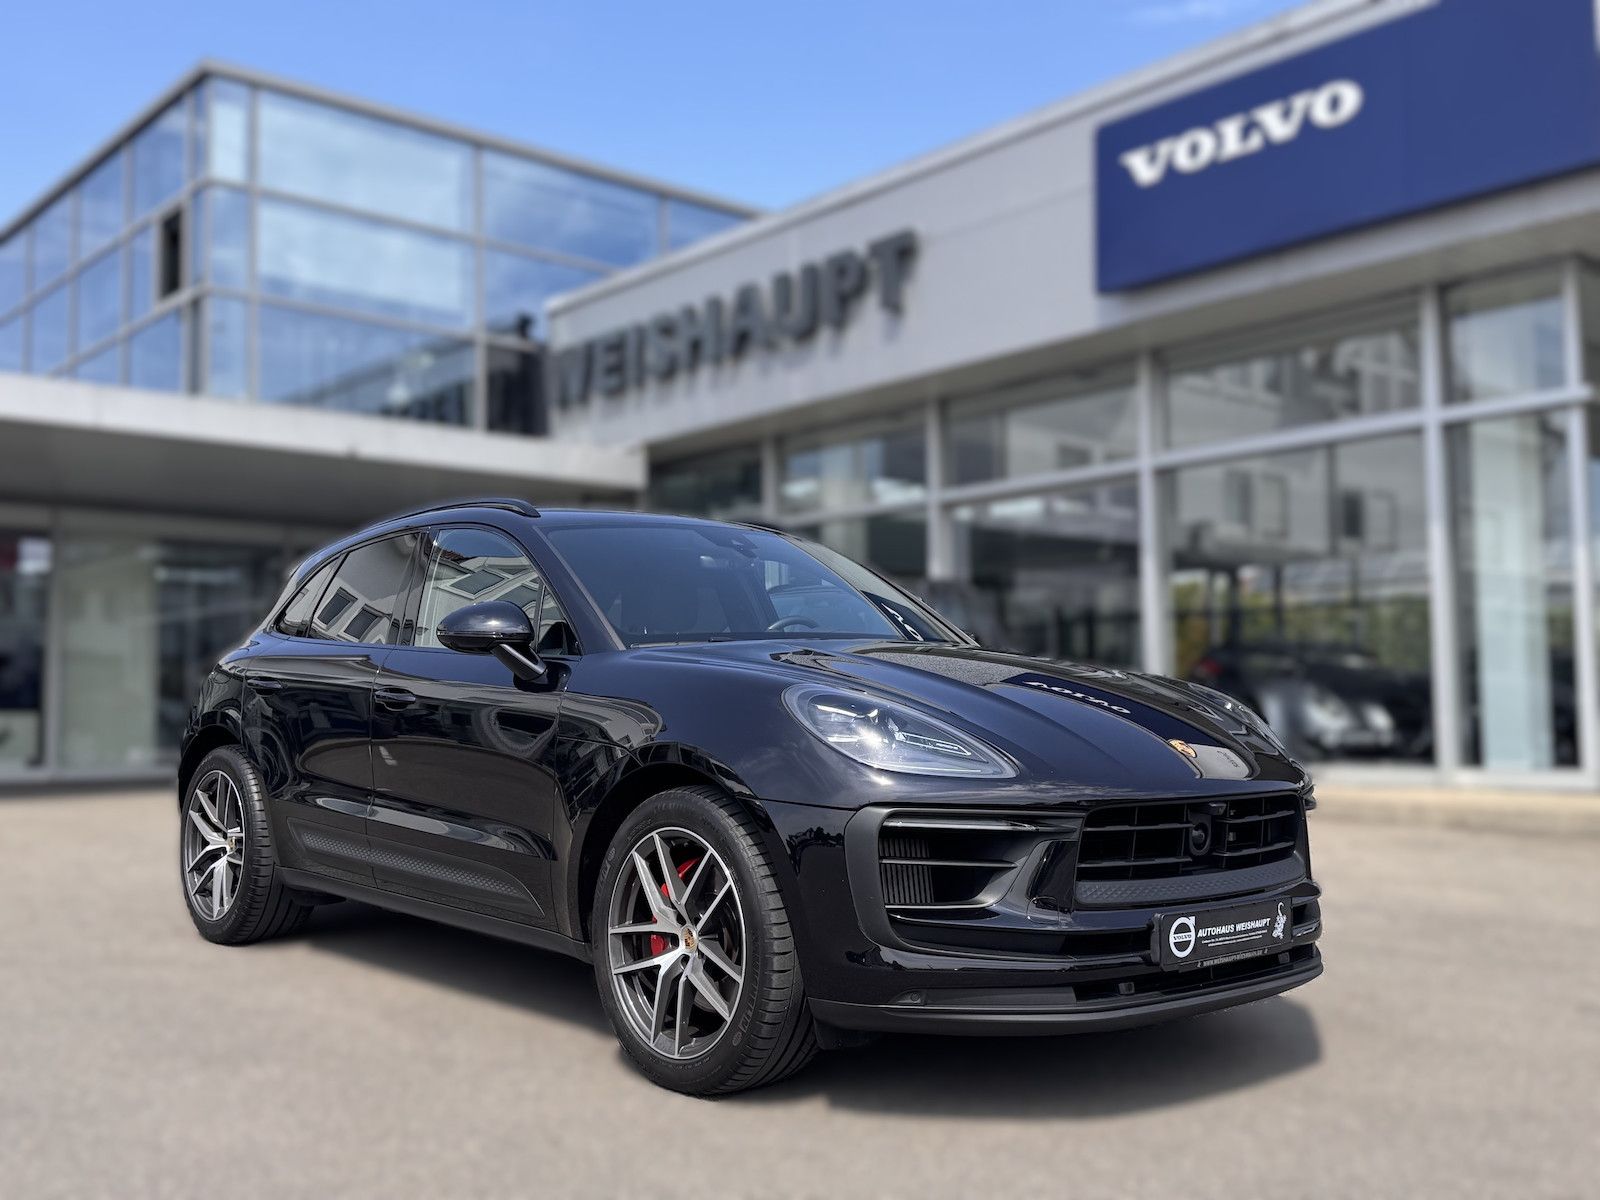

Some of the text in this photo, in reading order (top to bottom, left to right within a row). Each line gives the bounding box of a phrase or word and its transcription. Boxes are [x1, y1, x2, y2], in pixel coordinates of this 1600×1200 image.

[1120, 80, 1363, 188] VOLVO
[545, 230, 919, 410] WEISHAUPT
[1173, 934, 1193, 942] VOLVO
[1197, 923, 1235, 938] AUTOHAUS
[1235, 917, 1271, 931] WEISHAUPT
